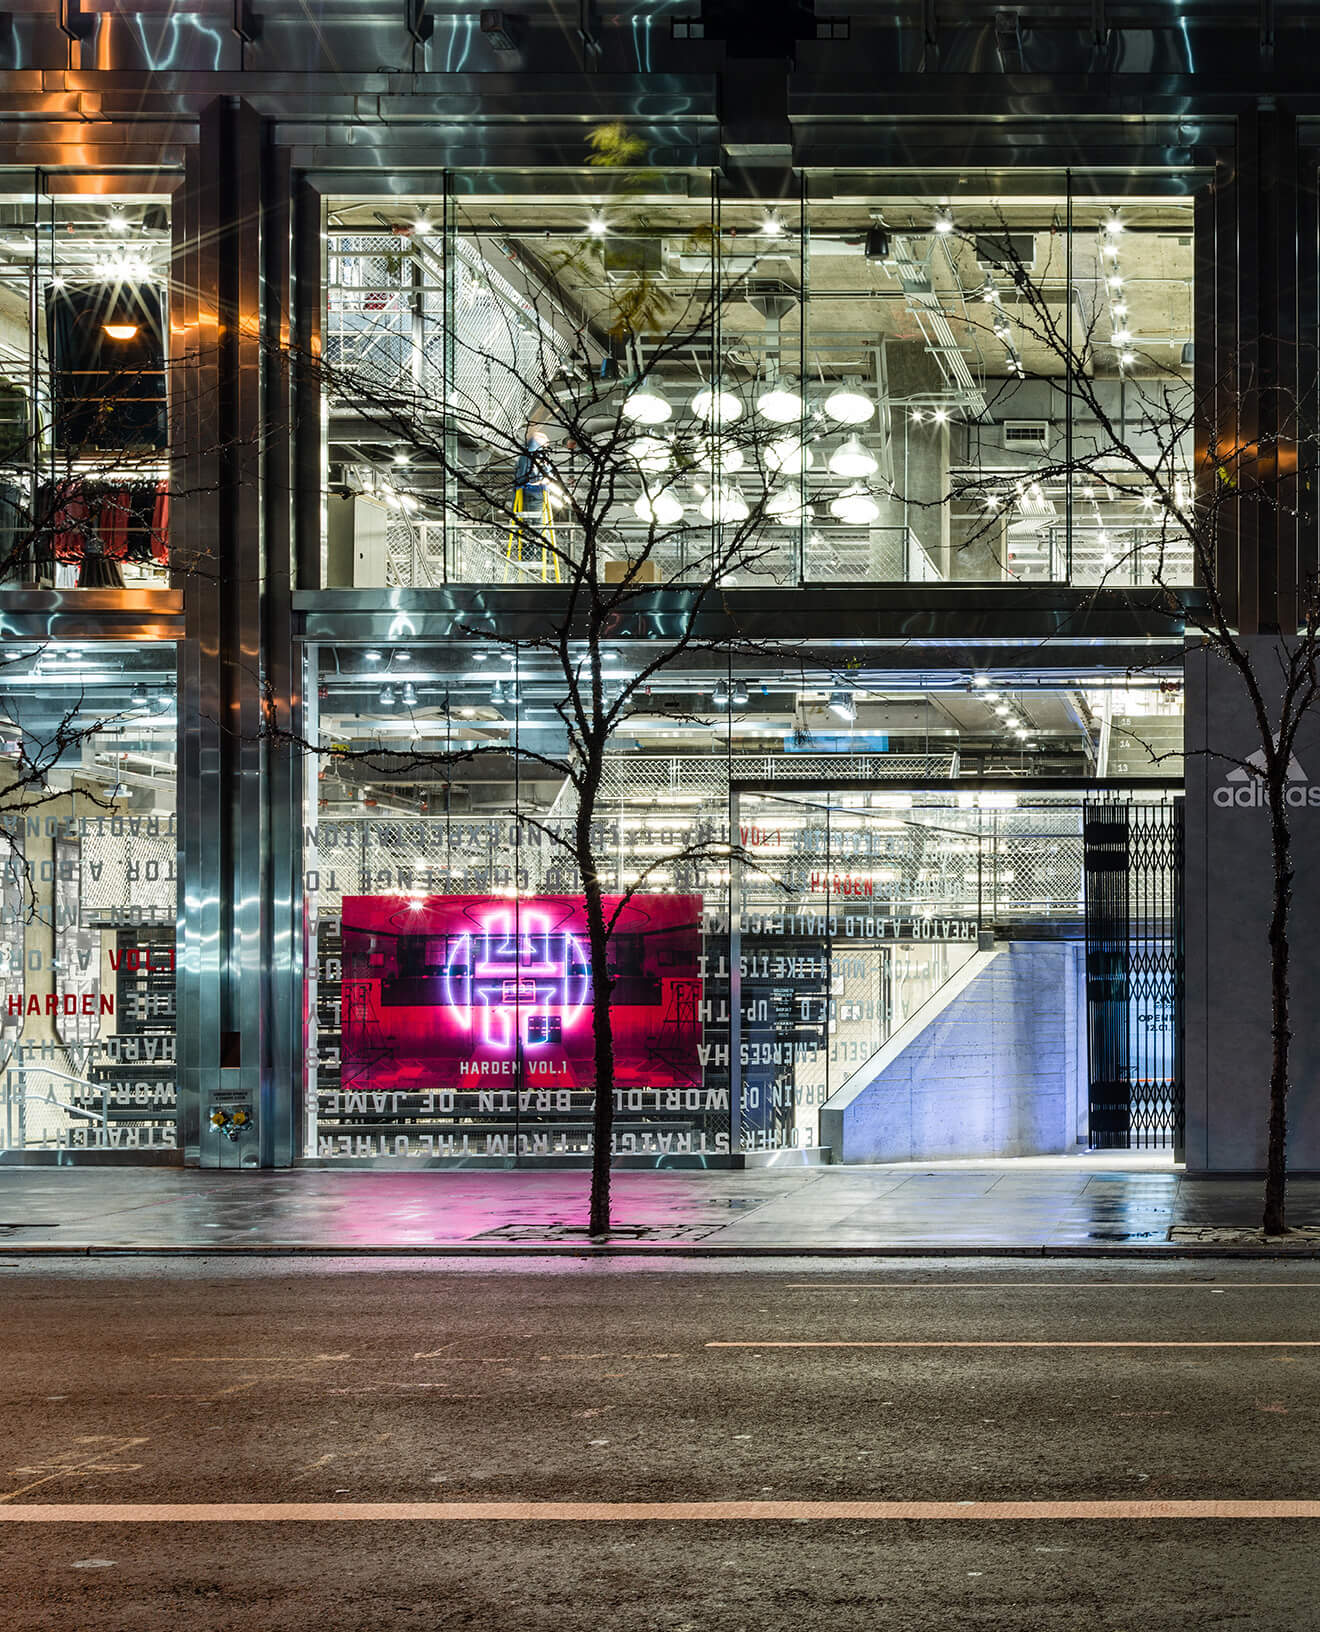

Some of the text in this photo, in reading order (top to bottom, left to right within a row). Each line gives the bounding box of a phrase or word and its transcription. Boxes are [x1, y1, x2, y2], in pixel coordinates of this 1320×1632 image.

[811, 871, 873, 896] HARDEN
[8, 994, 114, 1016] HARDEN
[460, 1061, 567, 1075] HARDEN VOL.1
[419, 1090, 454, 1112] OF
[478, 1089, 571, 1112] BRAIN
[590, 1088, 729, 1111] WORLDL
